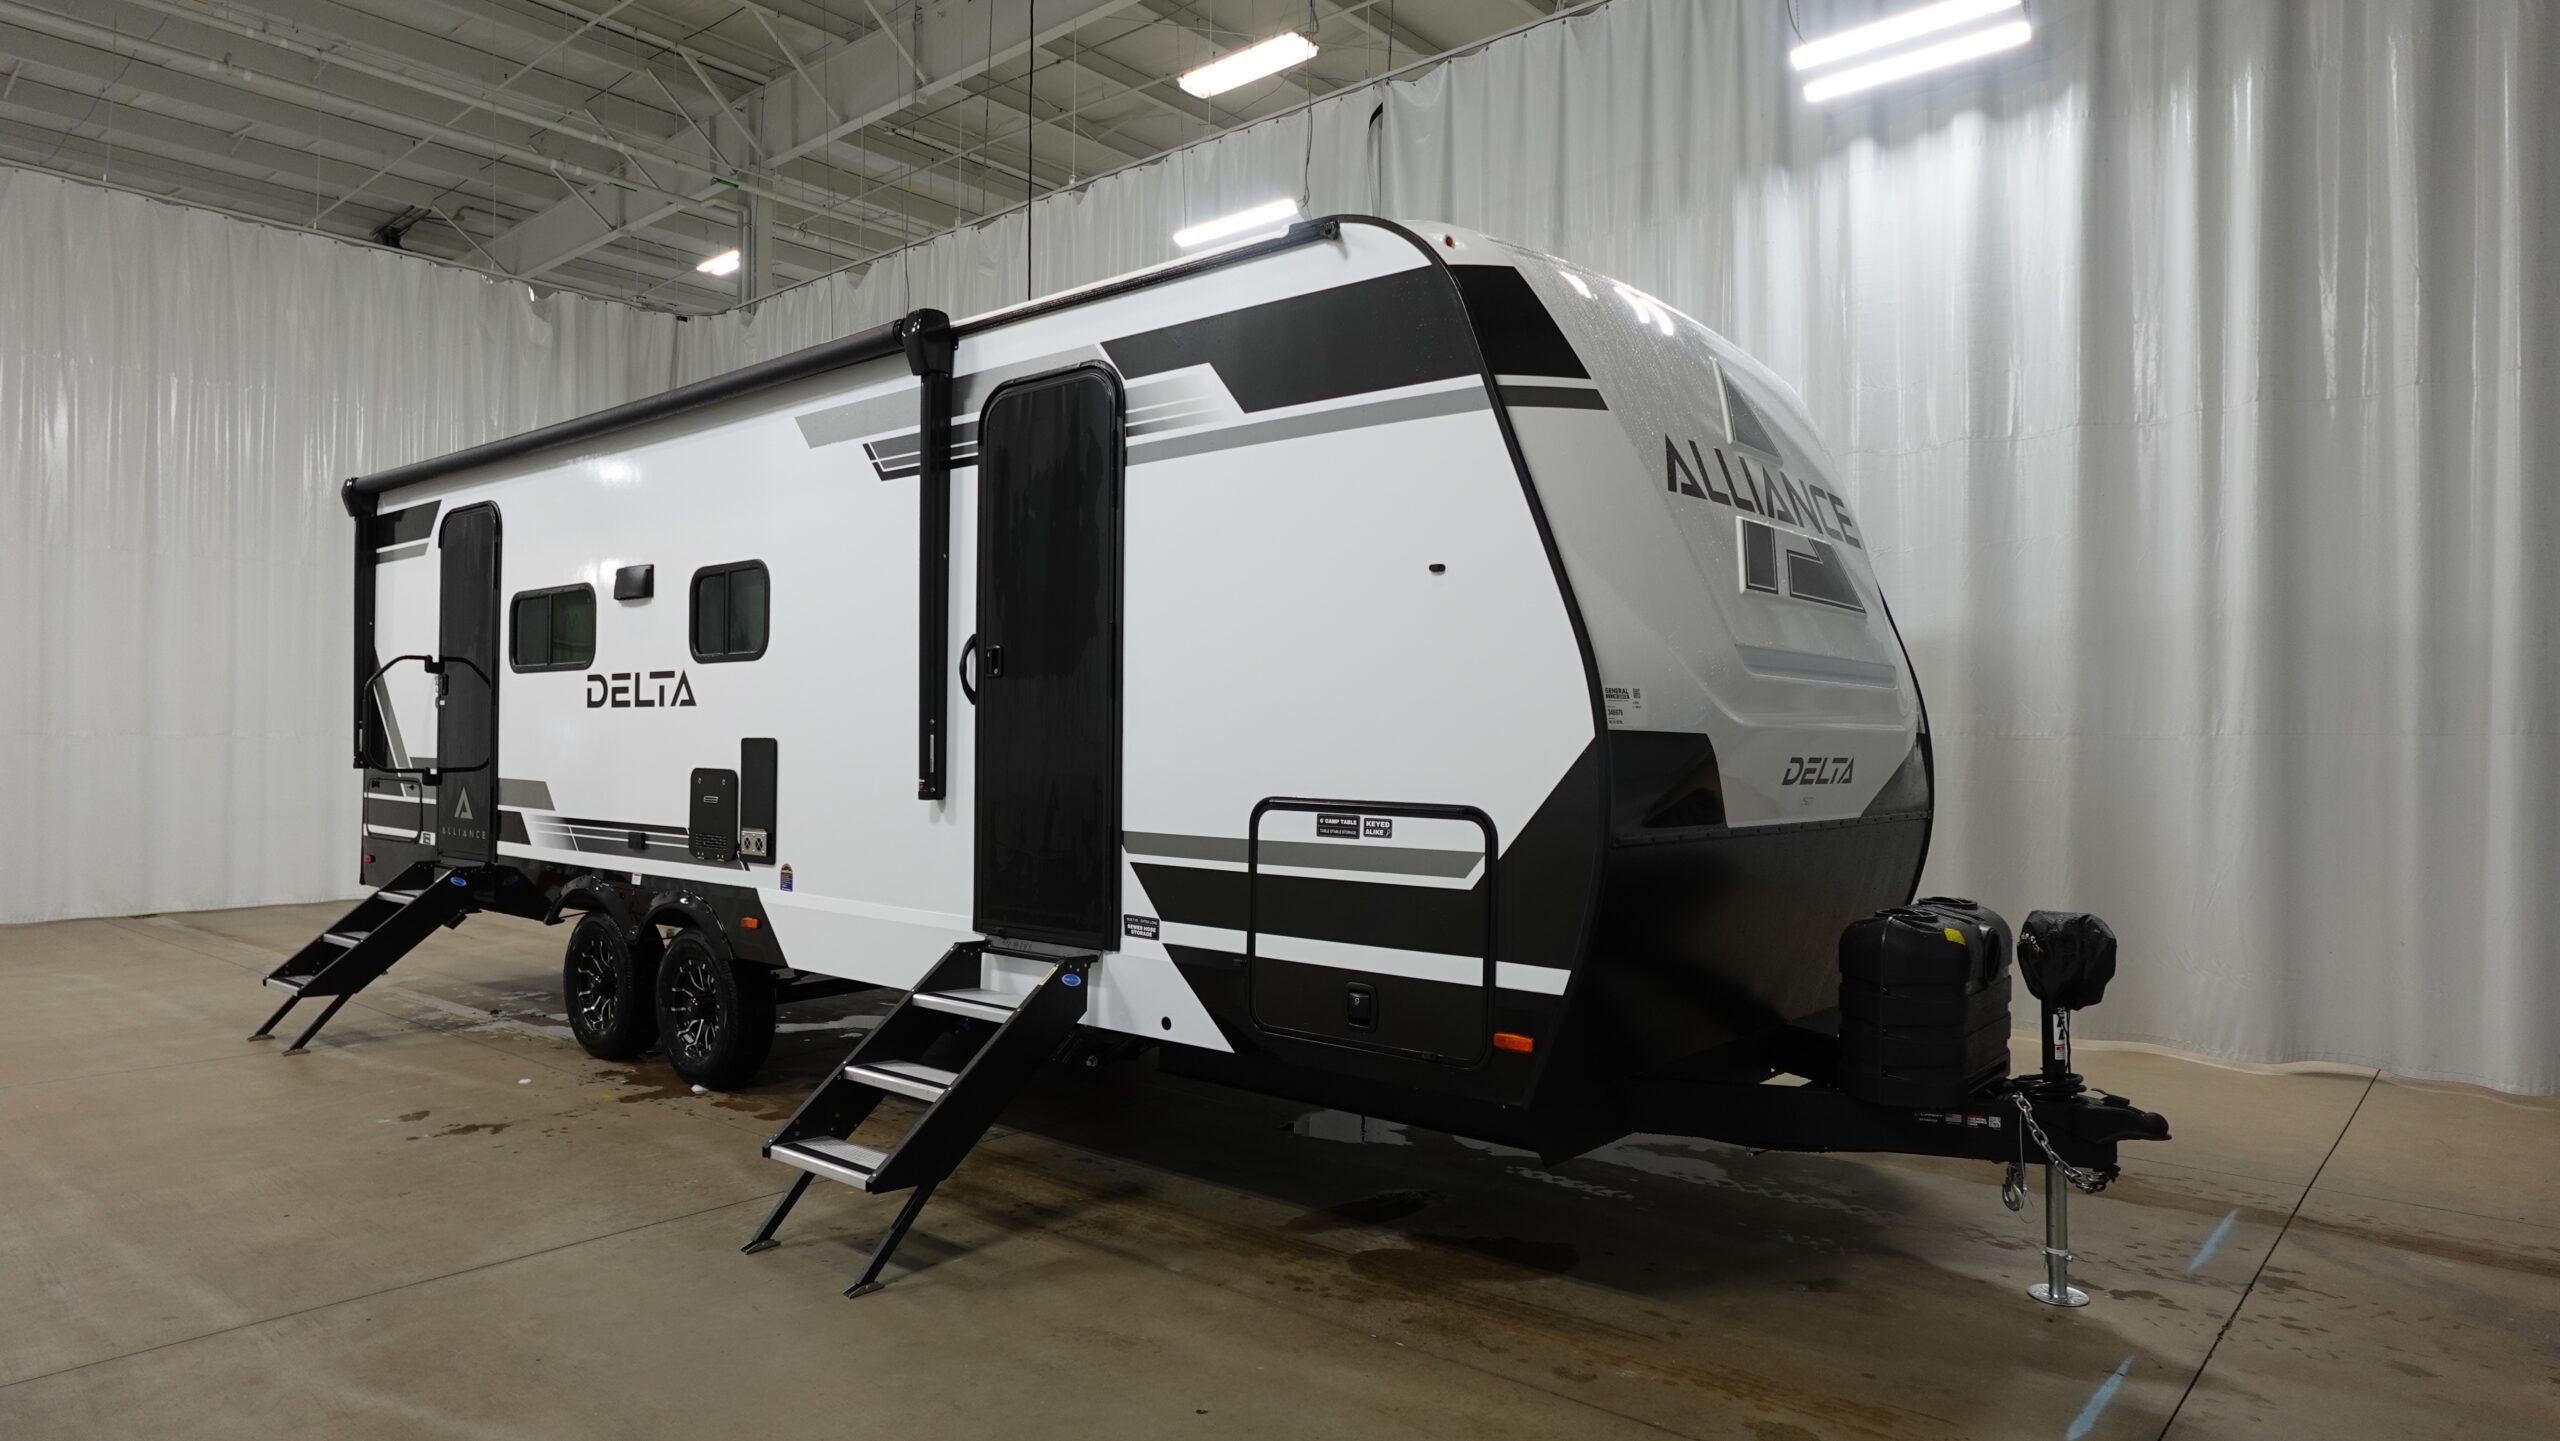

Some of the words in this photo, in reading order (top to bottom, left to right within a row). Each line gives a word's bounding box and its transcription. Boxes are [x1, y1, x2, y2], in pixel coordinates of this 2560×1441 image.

[1665, 433, 1862, 550] ALLIANCE
[587, 669, 697, 708] DELTA
[1782, 756, 1855, 786] DELTA
[441, 826, 487, 840] ALLIANCE
[1365, 820, 1390, 828] KEYED
[1365, 828, 1384, 836] ALIKE
